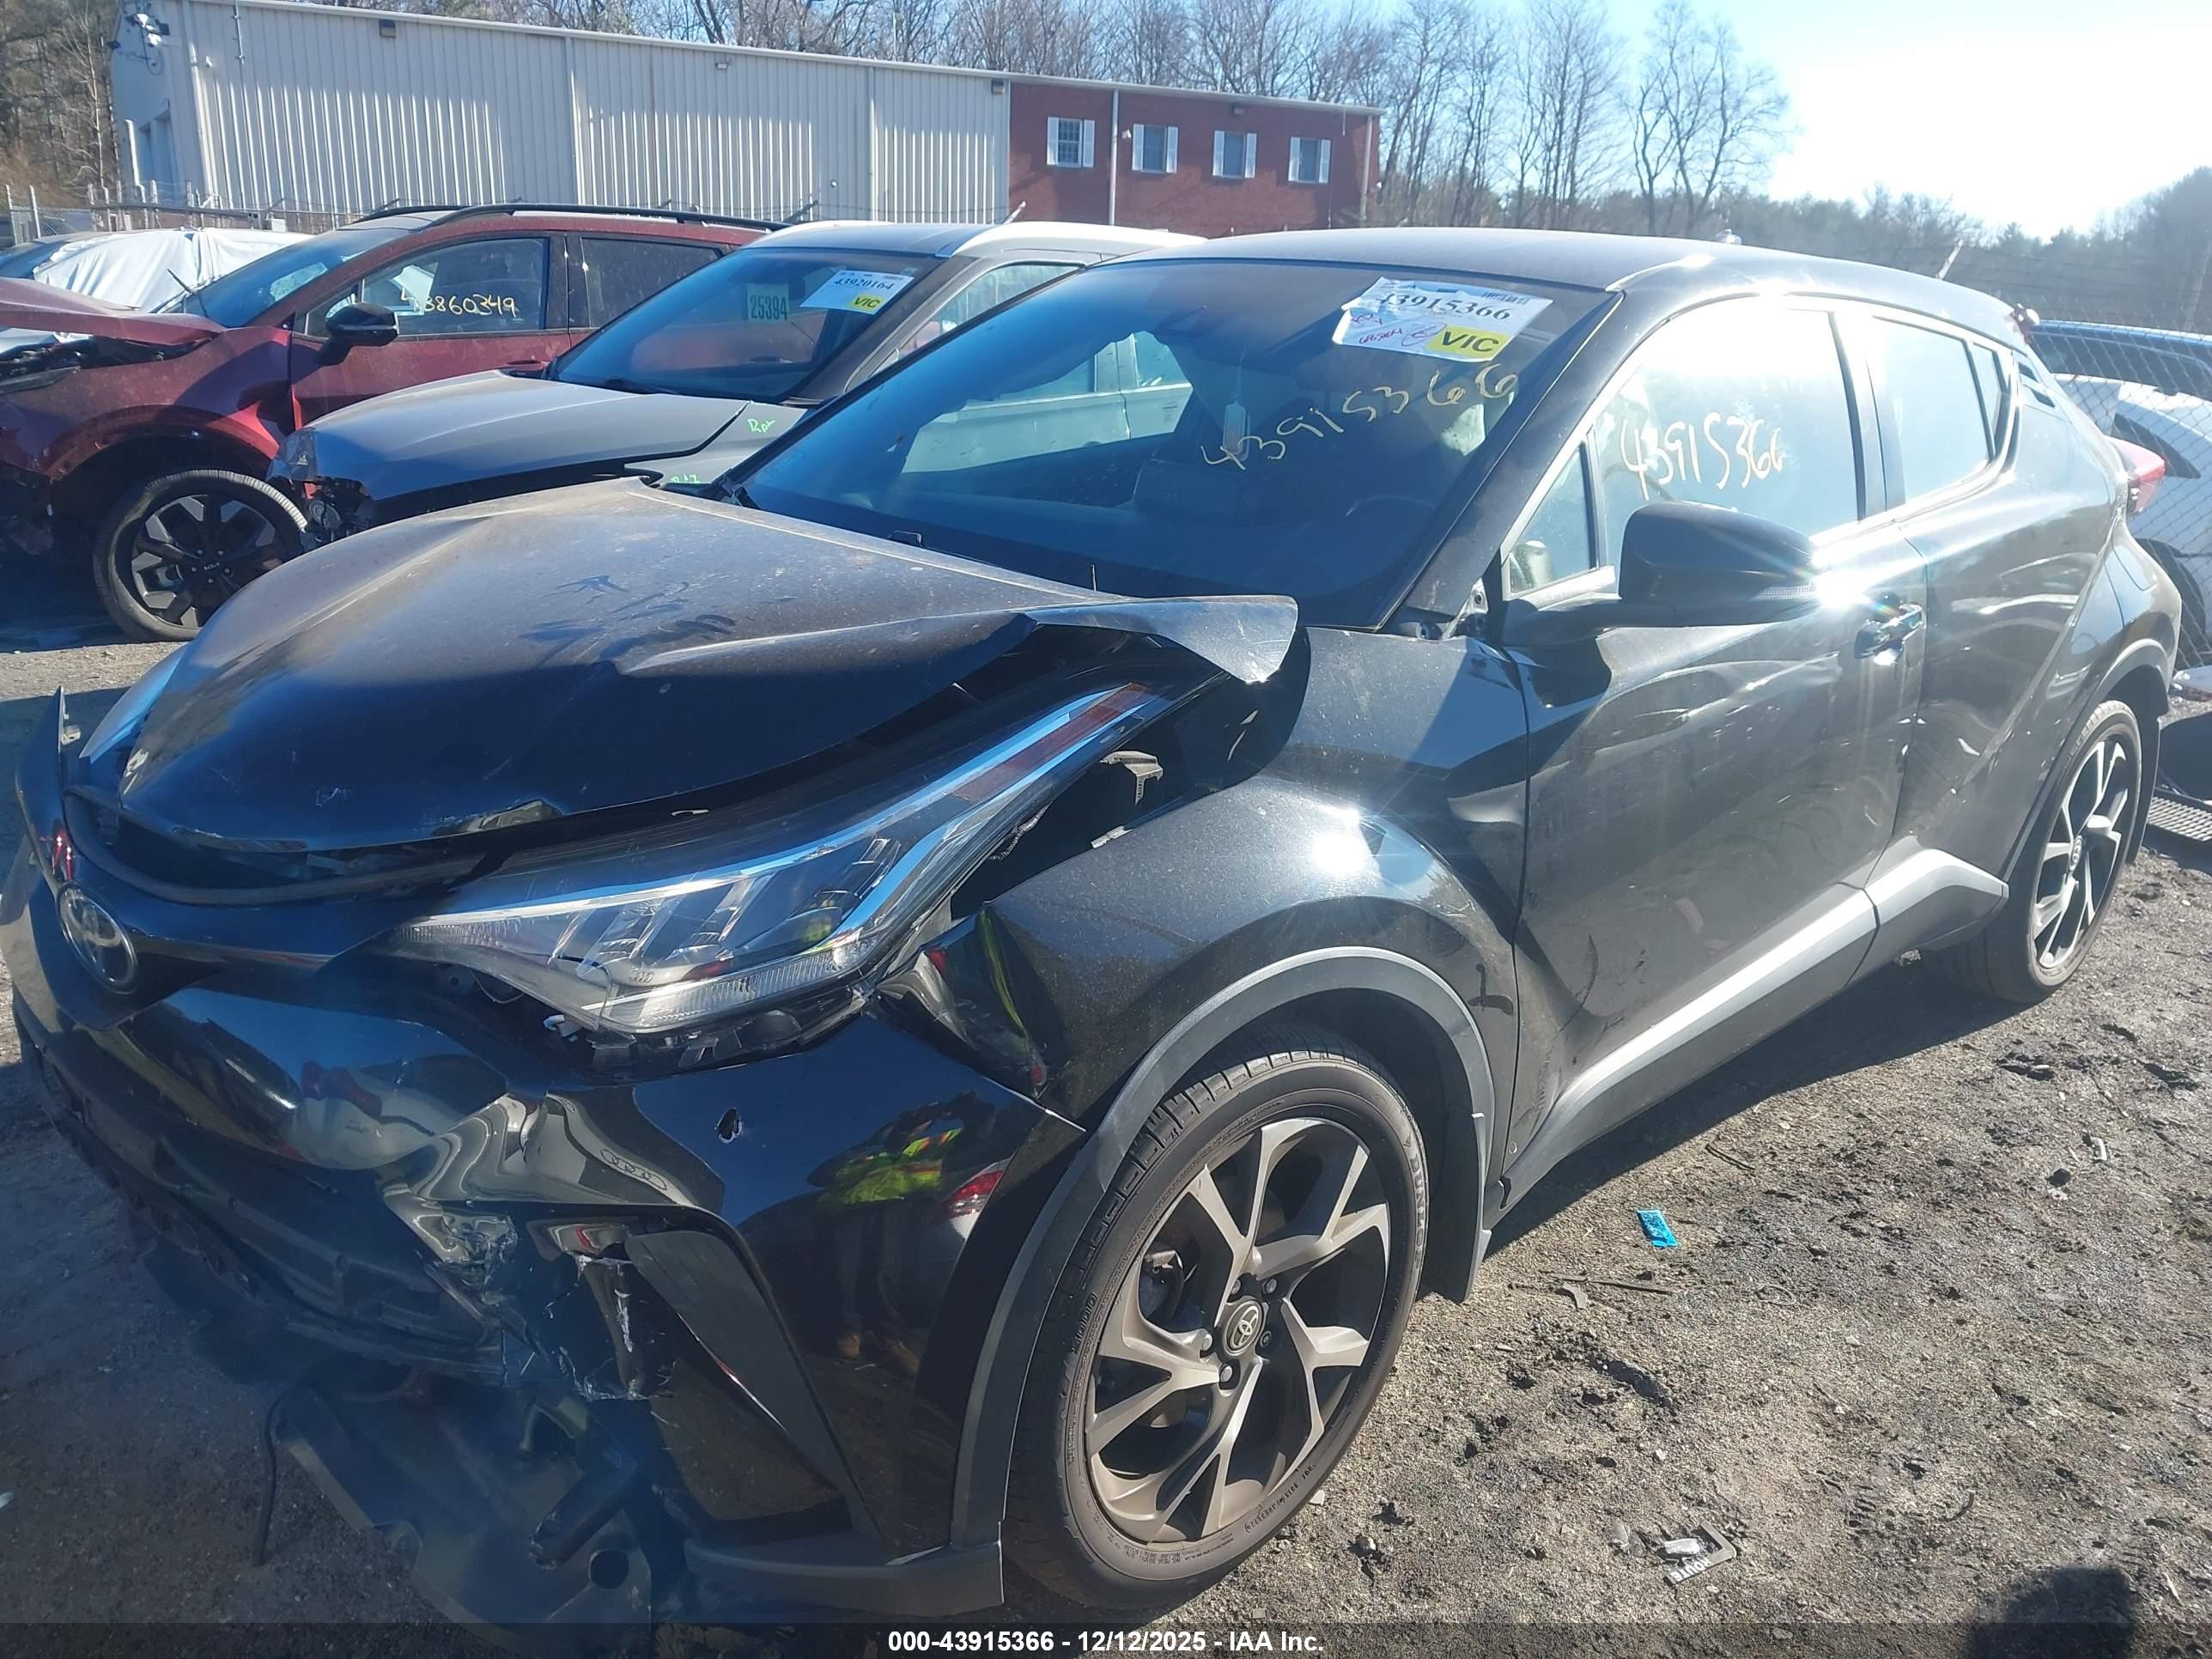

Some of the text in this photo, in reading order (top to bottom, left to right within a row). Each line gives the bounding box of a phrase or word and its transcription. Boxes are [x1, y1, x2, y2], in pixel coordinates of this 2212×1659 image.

[750, 295, 788, 320] 25394
[854, 296, 880, 308] VIC
[1442, 331, 1499, 353] VIC
[1200, 362, 1519, 471] 43915366
[1620, 411, 1787, 501] 43915366
[1670, 1557, 1711, 1582] ROUTE
